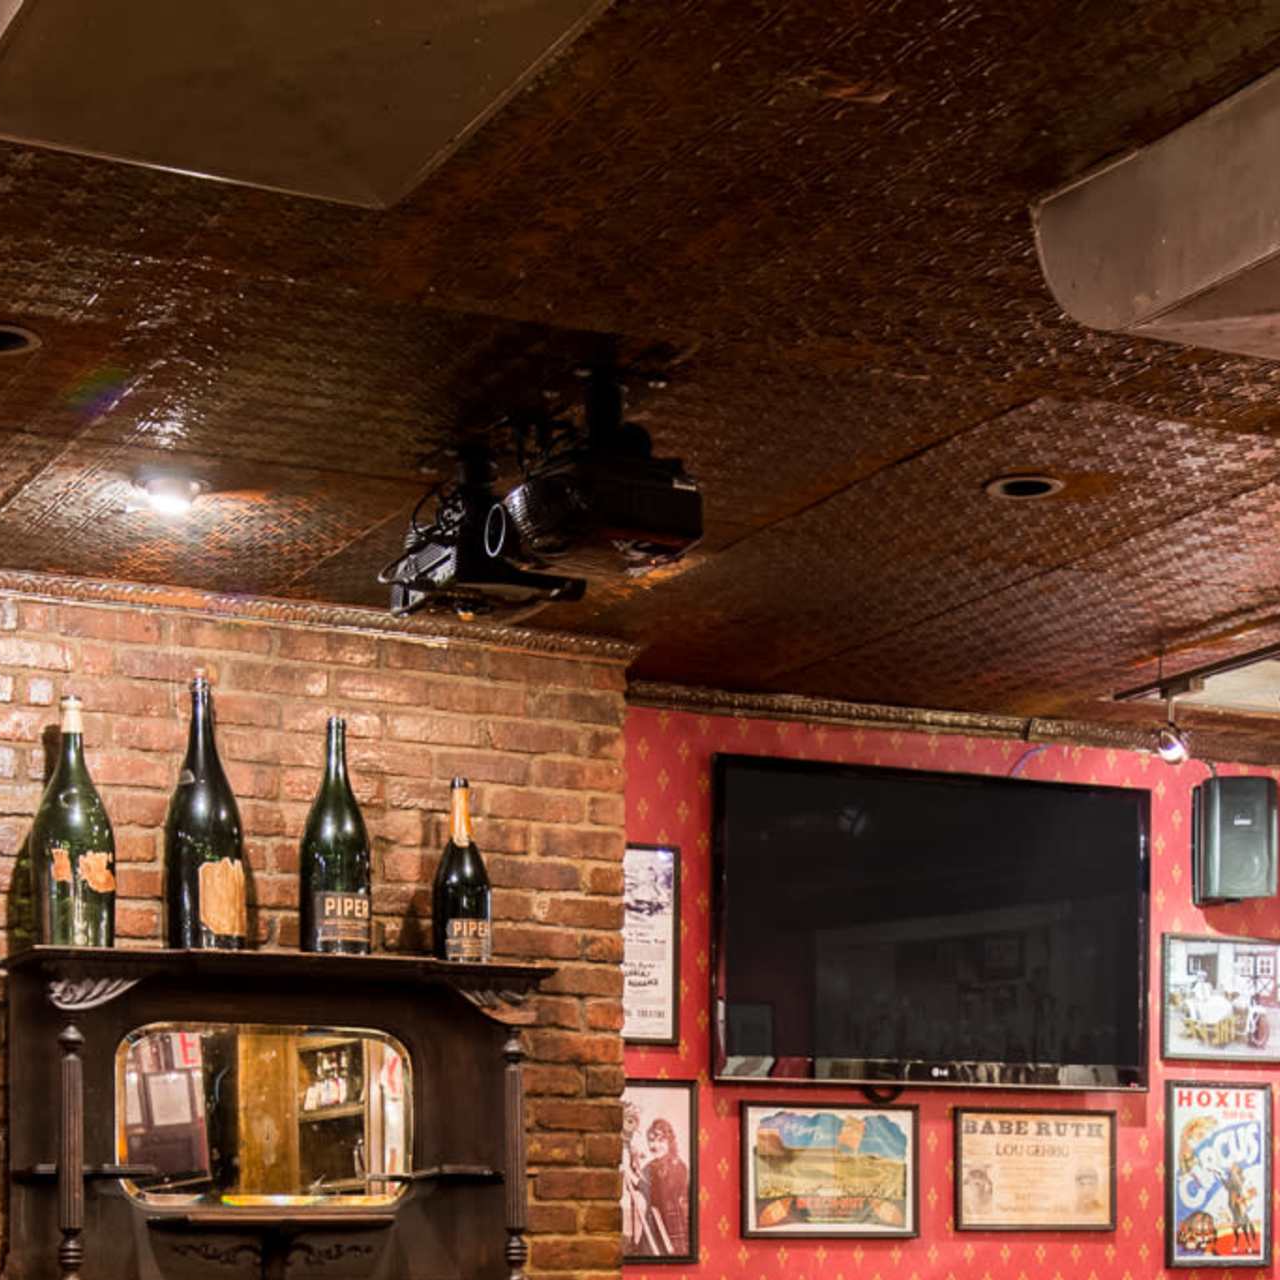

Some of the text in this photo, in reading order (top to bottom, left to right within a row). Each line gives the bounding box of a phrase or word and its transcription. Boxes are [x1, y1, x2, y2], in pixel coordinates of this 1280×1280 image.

[324, 896, 369, 918] PIPER
[1177, 1090, 1256, 1109] HOXIE
[963, 1119, 1104, 1139] BABE RUTH
[995, 1142, 1024, 1157] LOU
[1179, 1122, 1260, 1210] CIRCUS
